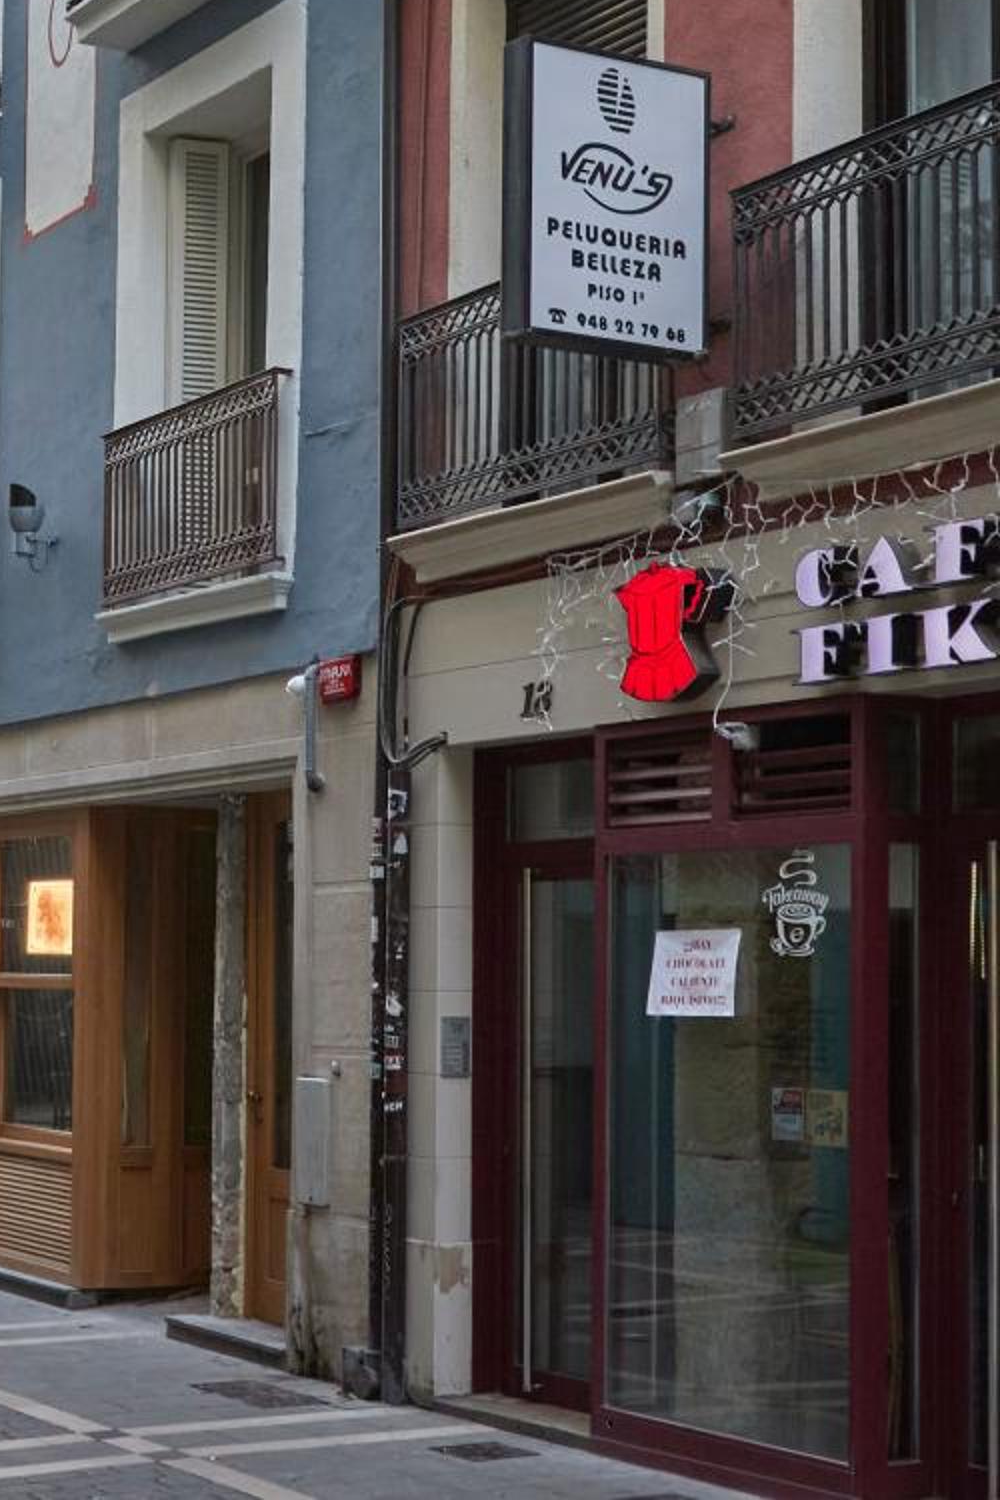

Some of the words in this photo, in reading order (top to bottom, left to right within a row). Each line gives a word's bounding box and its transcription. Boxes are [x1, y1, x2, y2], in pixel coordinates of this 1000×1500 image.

[561, 142, 673, 203] VENU'S
[547, 217, 687, 260] PELUQUERIA
[570, 249, 662, 282] BELLEZA
[587, 283, 625, 303] PISO
[576, 312, 608, 331] 948
[615, 318, 635, 335] 22
[641, 323, 659, 339] 79
[666, 326, 686, 343] 68
[798, 598, 996, 684] FIK
[761, 882, 829, 914] Takeaway
